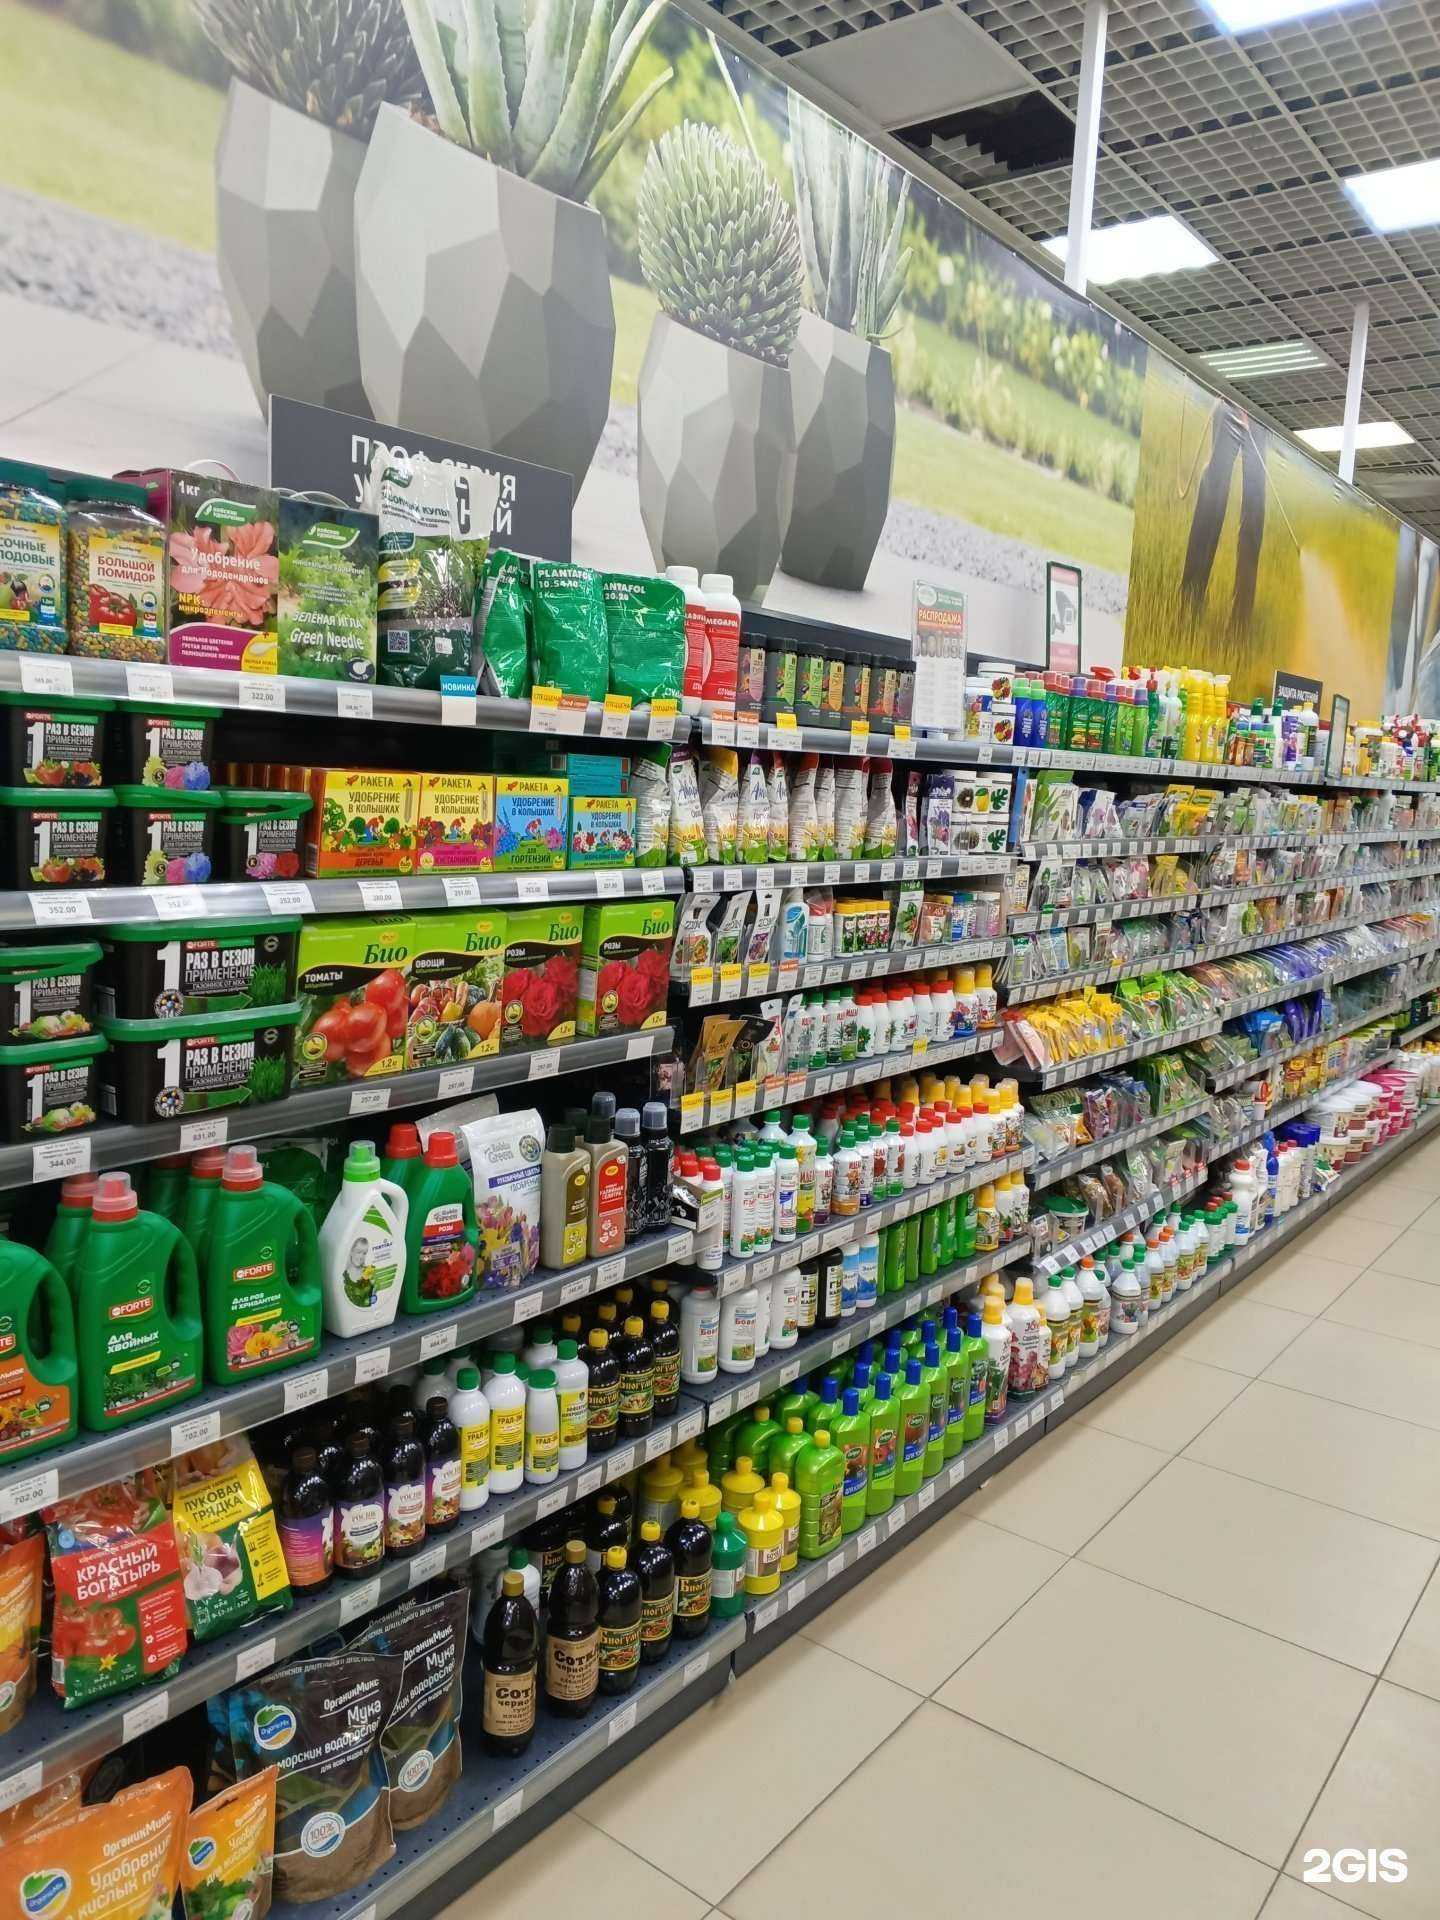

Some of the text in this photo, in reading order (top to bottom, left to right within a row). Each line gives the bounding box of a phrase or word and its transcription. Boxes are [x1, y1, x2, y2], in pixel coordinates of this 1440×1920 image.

[97, 555, 155, 572] БОЛЬШОЙ
[191, 547, 261, 571] Удобрение
[97, 566, 156, 583] ПОМИДОР
[537, 569, 592, 581] PLANTAFOL
[918, 608, 962, 625] РАСПРОДАЖА
[290, 627, 364, 649] Green Needle
[442, 682, 476, 693] НОВИНКА
[27, 721, 44, 769] 1
[46, 723, 61, 735] РАЗ
[64, 724, 69, 736] В
[71, 724, 95, 737] СЕЗОН
[46, 735, 94, 746] ПРИМЕНЕНИЕ
[146, 727, 160, 757] 1
[162, 727, 176, 740] РАЗ
[183, 728, 203, 741] СЕЗОН
[360, 777, 393, 787] РАКЕТА
[441, 777, 472, 788] РАКЕТА
[519, 781, 549, 792] РАКЕТА
[349, 791, 400, 804] УДОБРЕНИЕ
[434, 794, 480, 805] УДОБРЕНИЕ
[512, 797, 555, 807] УДОБРЕНИЕ
[595, 800, 619, 809] РАКЕТА
[349, 804, 400, 814] В КОЛЫШКАХ
[434, 805, 480, 815] В КОЛЫШКАХ
[512, 806, 555, 816] В КОЛЫШКАХ
[52, 832, 98, 842] ПРИМЕНЕНИЕ
[147, 821, 161, 851] 1
[163, 821, 175, 832] РАЗ
[185, 820, 204, 832] СЕЗОН
[244, 823, 257, 856] 1
[259, 820, 272, 831] РАЗ
[279, 819, 298, 830] СЕЗОН
[33, 821, 51, 868] 1
[52, 821, 67, 833] РАЗ
[70, 821, 75, 833] В
[76, 821, 99, 833] СЕЗОН
[511, 855, 551, 864] ГОРТЕНЗИИ
[549, 923, 579, 942] Био
[641, 919, 670, 936] Био
[464, 932, 501, 952] Био
[603, 942, 621, 951] РОЗЫ
[363, 944, 408, 965] Био
[506, 948, 526, 957] РОЗЫ
[157, 940, 255, 991] 1 РАЗ В СЕЗОН
[415, 958, 445, 968] ОВОЩИ
[185, 965, 257, 983] ПРИМЕНЕНИЕ
[305, 971, 343, 983] ТОМАТЫ
[32, 986, 81, 997] ПРИМЕНЕНИЕ
[14, 975, 81, 1028] 1 РАЗ В СЕЗОН
[157, 1039, 255, 1088] 1 РАЗ В СЕЗОН
[185, 1058, 255, 1079] ПРИМЕНЕНИЕ
[44, 1078, 89, 1091] ПРИМЕНЕНИЕ
[27, 1067, 89, 1122] 1 РАЗ В СЕЗОН
[244, 1262, 273, 1277] FORTE
[121, 1297, 151, 1314] FORTE
[239, 1293, 281, 1310] ХРИЗАНТЕМ
[107, 1330, 159, 1354] ХВОЙНЫХ
[108, 1331, 133, 1346] ДЛЯ
[14, 1488, 44, 1505] 702.00
[184, 1481, 242, 1513] ЛУКОВАЯ
[192, 1495, 243, 1523] ГРЯДКА
[77, 1544, 158, 1584] КРАСНЫЙ
[77, 1561, 161, 1601] БОГАТЫРЬ
[403, 1624, 453, 1662] ОрганикМикс
[426, 1643, 455, 1671] Мука
[323, 1679, 380, 1712] ОрганикМикс
[347, 1700, 382, 1726] Мука
[277, 1746, 323, 1770] морских
[103, 1810, 173, 1858] ОрганикМикс
[309, 1823, 335, 1842] 100%
[78, 1877, 138, 1920] кислых
